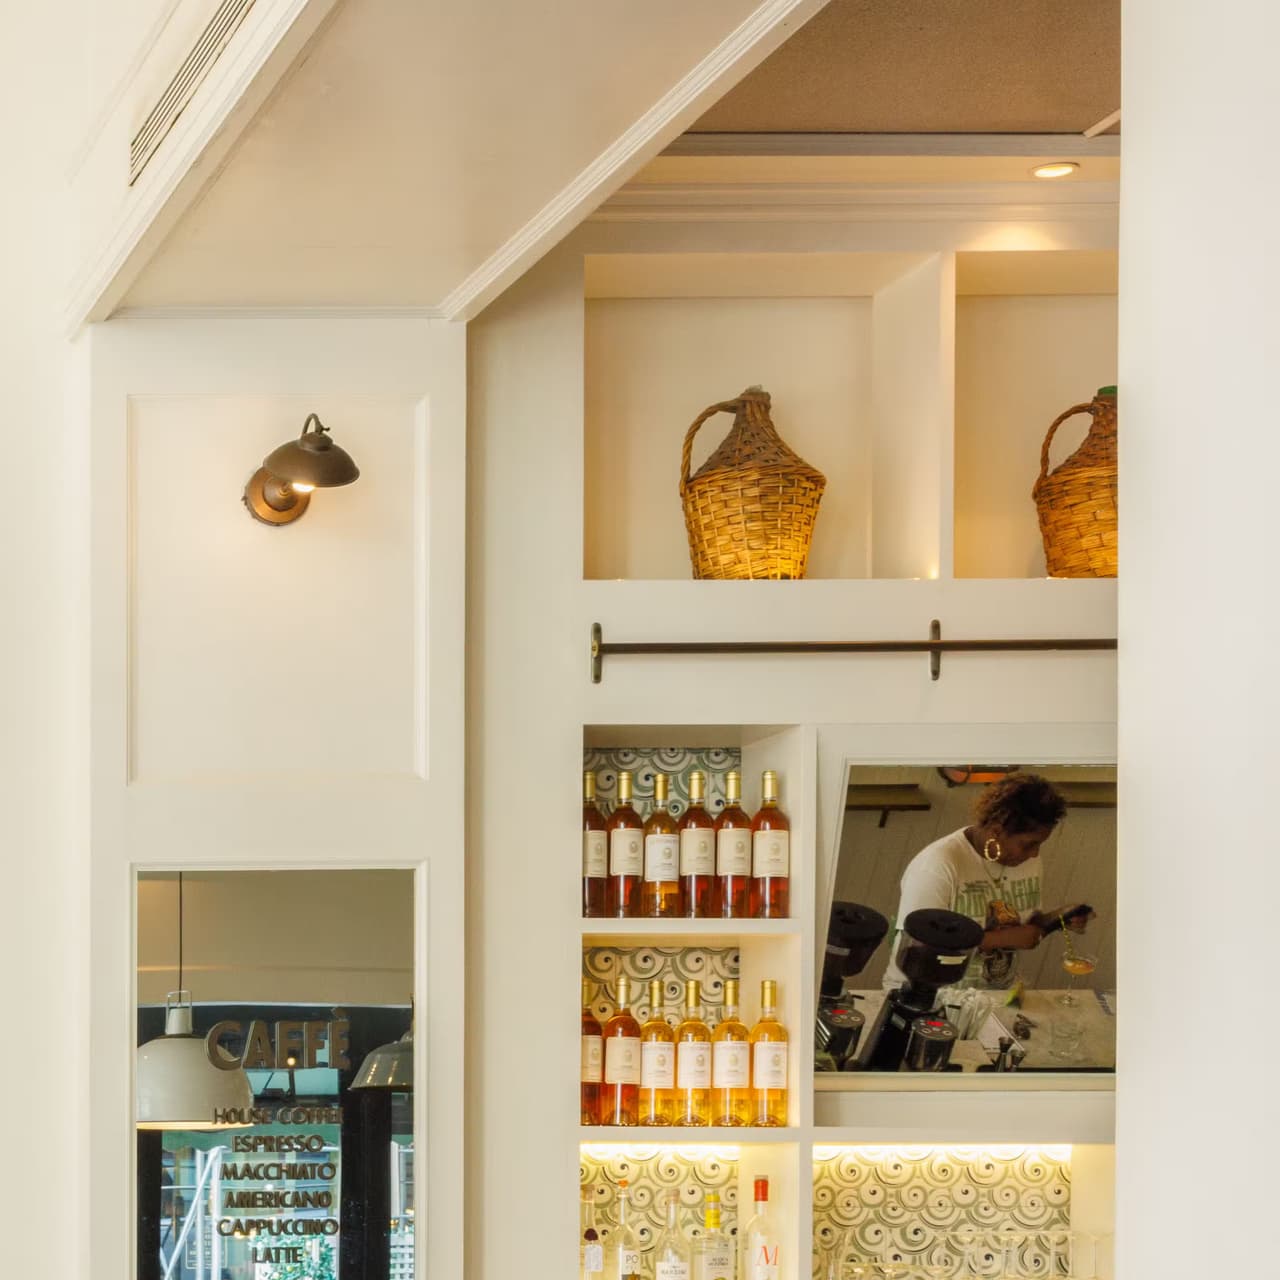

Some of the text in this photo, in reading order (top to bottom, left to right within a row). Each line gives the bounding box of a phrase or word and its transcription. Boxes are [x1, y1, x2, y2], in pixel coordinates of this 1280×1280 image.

[213, 1107, 344, 1125] HOUSE COFFEE
[232, 1135, 325, 1153] ESPRESSO
[219, 1162, 337, 1181] MACCHIATO
[224, 1191, 333, 1209] AMERICANO
[216, 1218, 339, 1237] CAPPUCCINO
[252, 1246, 304, 1264] LATTE
